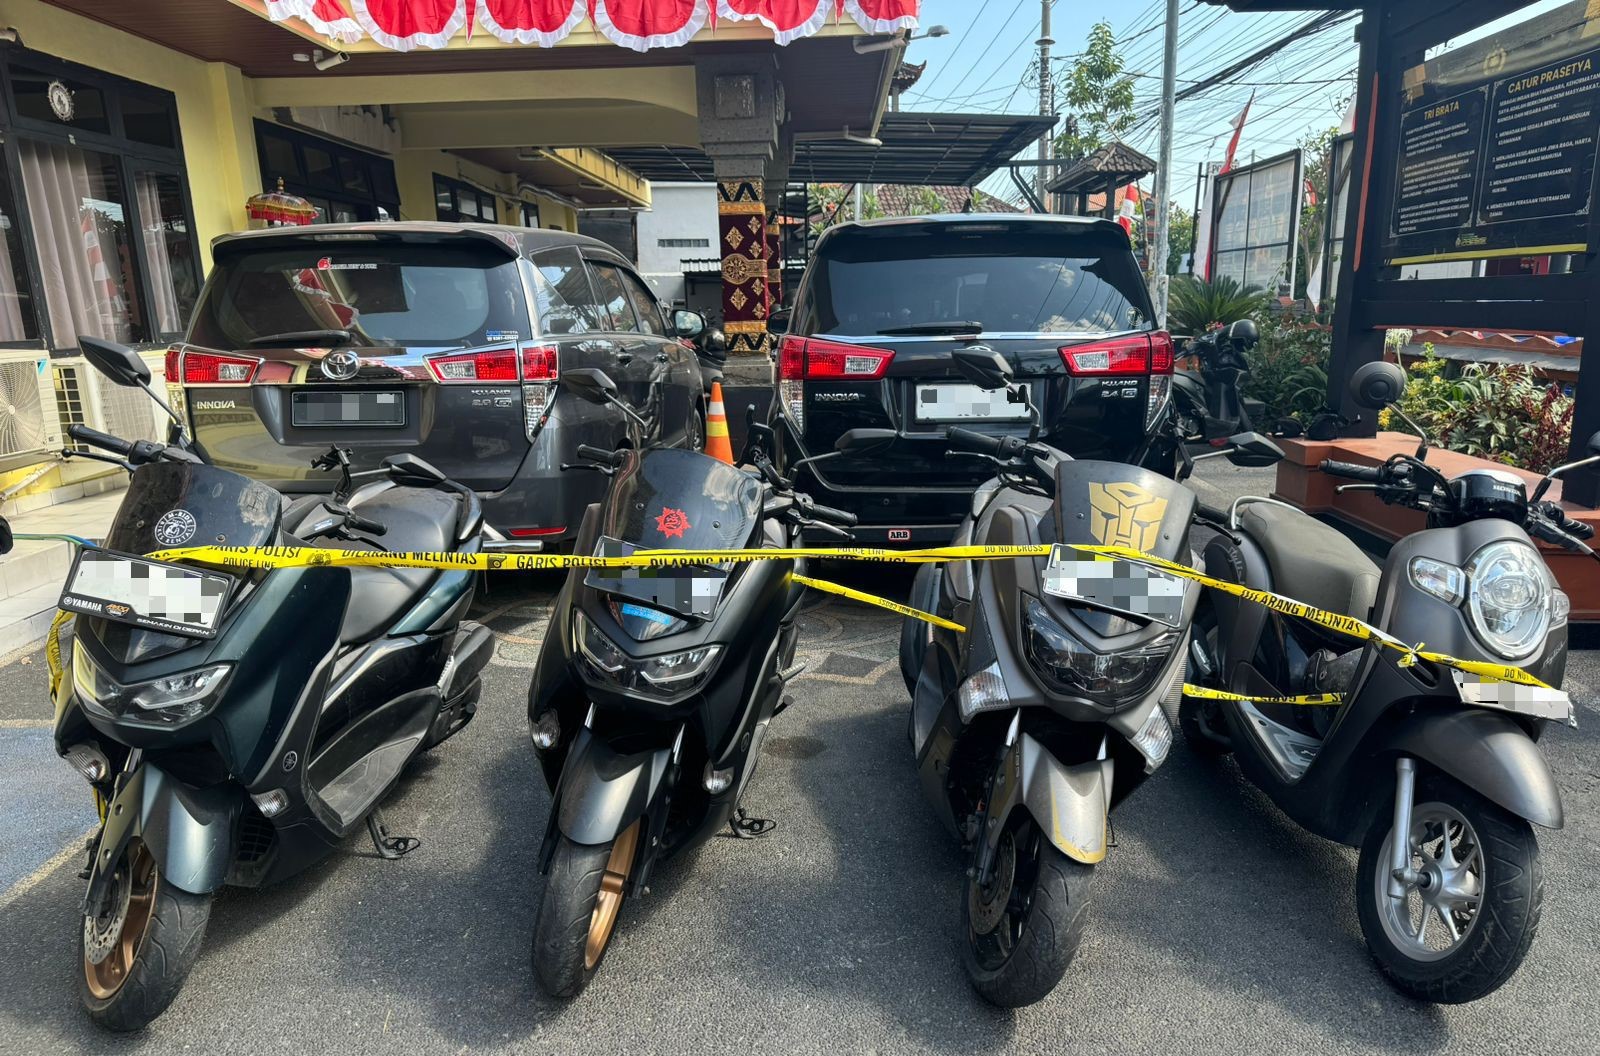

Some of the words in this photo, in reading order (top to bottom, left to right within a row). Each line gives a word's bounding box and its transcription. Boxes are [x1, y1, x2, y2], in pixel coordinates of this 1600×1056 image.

[1508, 75, 1539, 93] CATUR
[1540, 58, 1591, 84] PRASETYA
[1424, 108, 1434, 120] TRI
[1436, 100, 1460, 116] BRATA
[814, 392, 860, 401] INNOVA
[196, 400, 236, 409] INNOVA
[168, 511, 193, 524] M-RIDE
[223, 557, 252, 568] POLICE
[412, 552, 477, 564] MELINTAS
[516, 555, 557, 568] GARIS
[72, 598, 102, 612] YAMAHA
[1304, 606, 1362, 634] MELINTAS
[136, 618, 172, 630] SEMAKIN
[182, 626, 210, 636] DEPAN
[1504, 668, 1514, 678] DO
